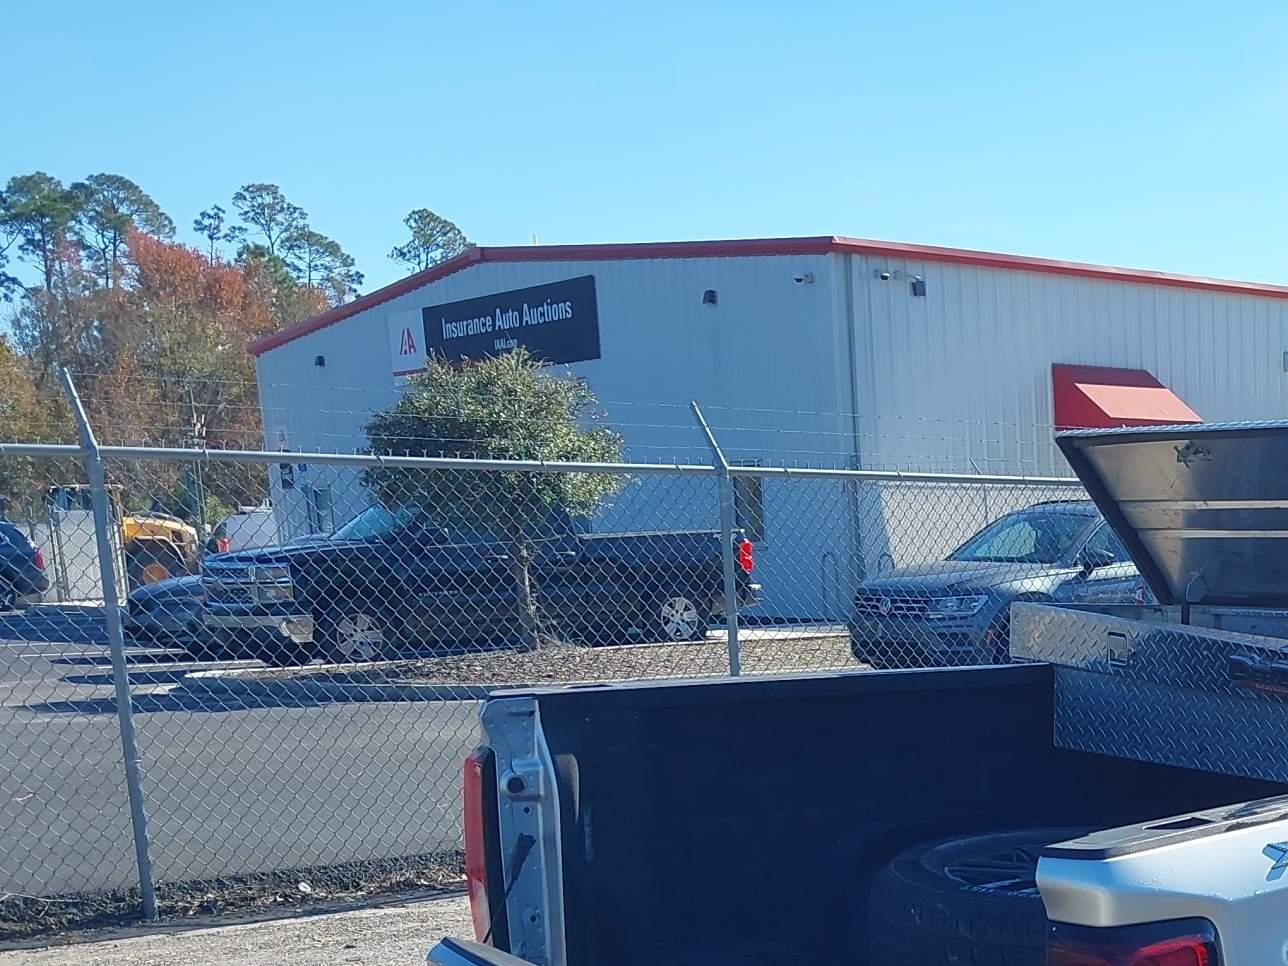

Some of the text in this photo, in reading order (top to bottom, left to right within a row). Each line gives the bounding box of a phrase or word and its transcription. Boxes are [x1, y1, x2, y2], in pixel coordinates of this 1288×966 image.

[442, 299, 573, 340] Insurance Auto Auctions
